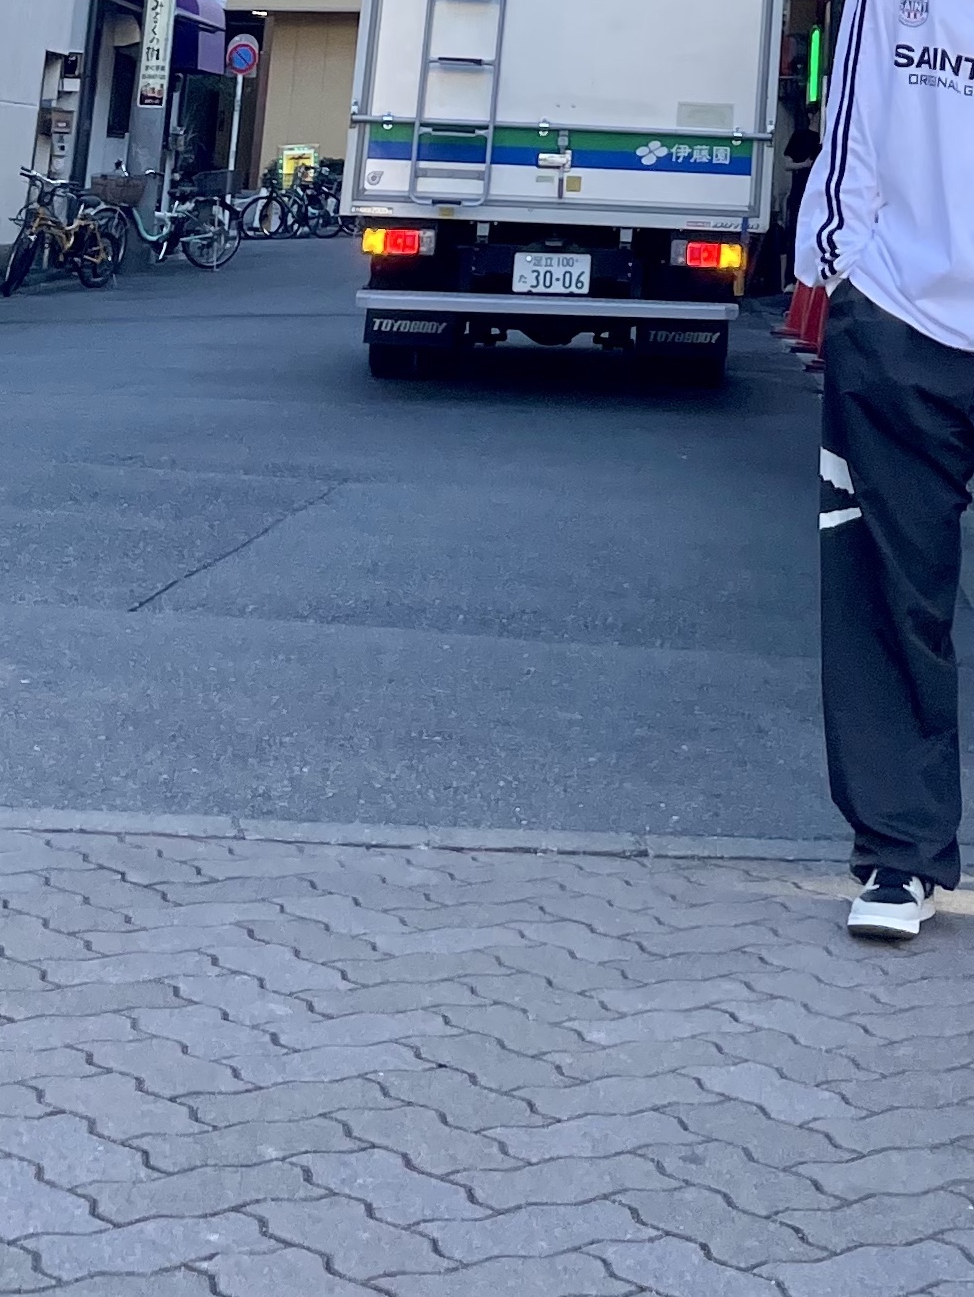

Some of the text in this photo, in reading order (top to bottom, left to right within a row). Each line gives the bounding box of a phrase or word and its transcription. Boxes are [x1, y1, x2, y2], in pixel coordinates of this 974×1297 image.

[670, 143, 731, 164] 伊藤園
[530, 269, 585, 289] 30-06
[372, 318, 447, 334] TOYOBODY
